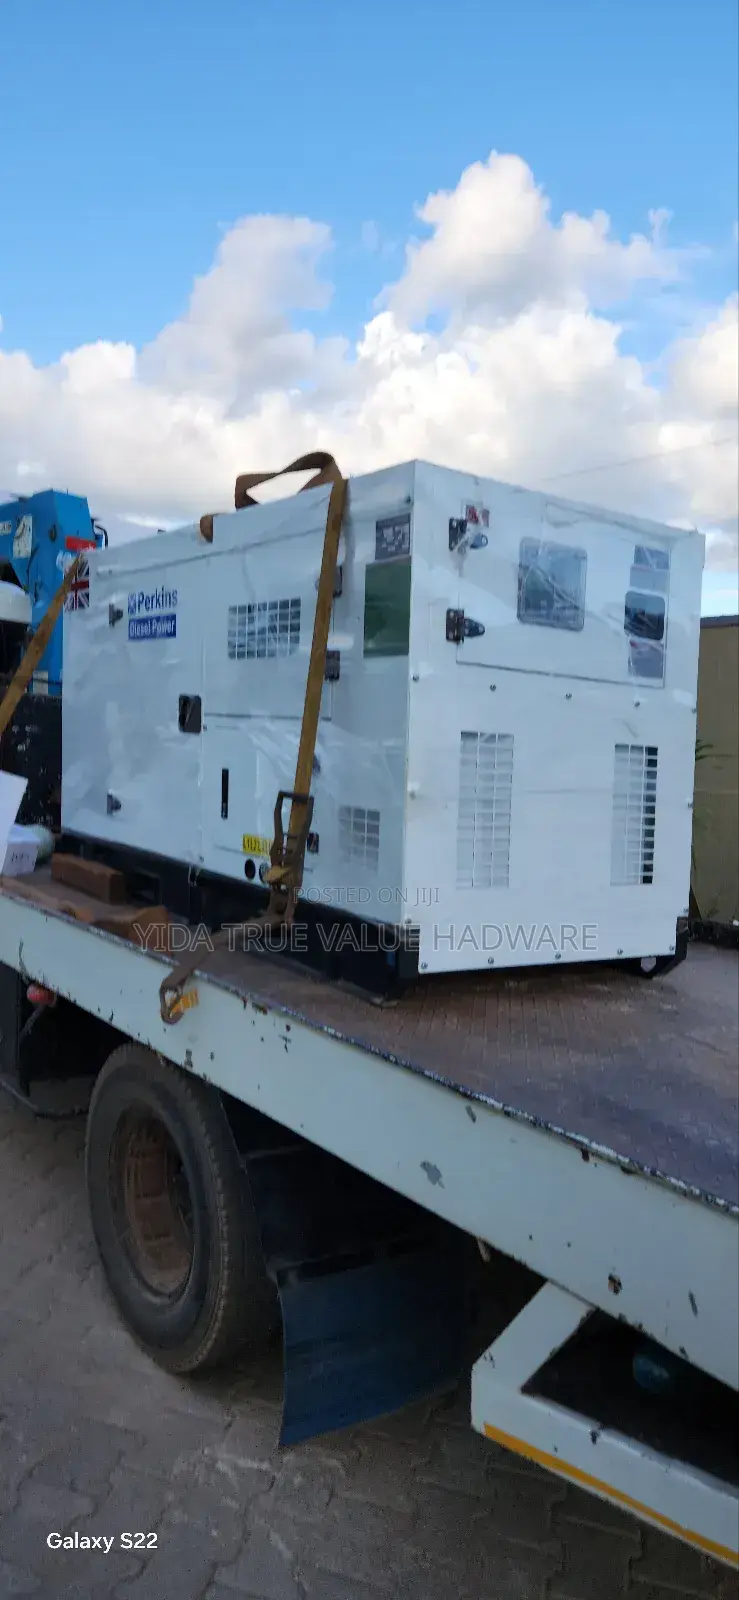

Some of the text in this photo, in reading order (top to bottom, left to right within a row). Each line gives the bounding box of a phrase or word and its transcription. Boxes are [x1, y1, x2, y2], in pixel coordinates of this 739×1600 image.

[137, 585, 178, 612] Perkins
[129, 618, 175, 638] Diesel Power
